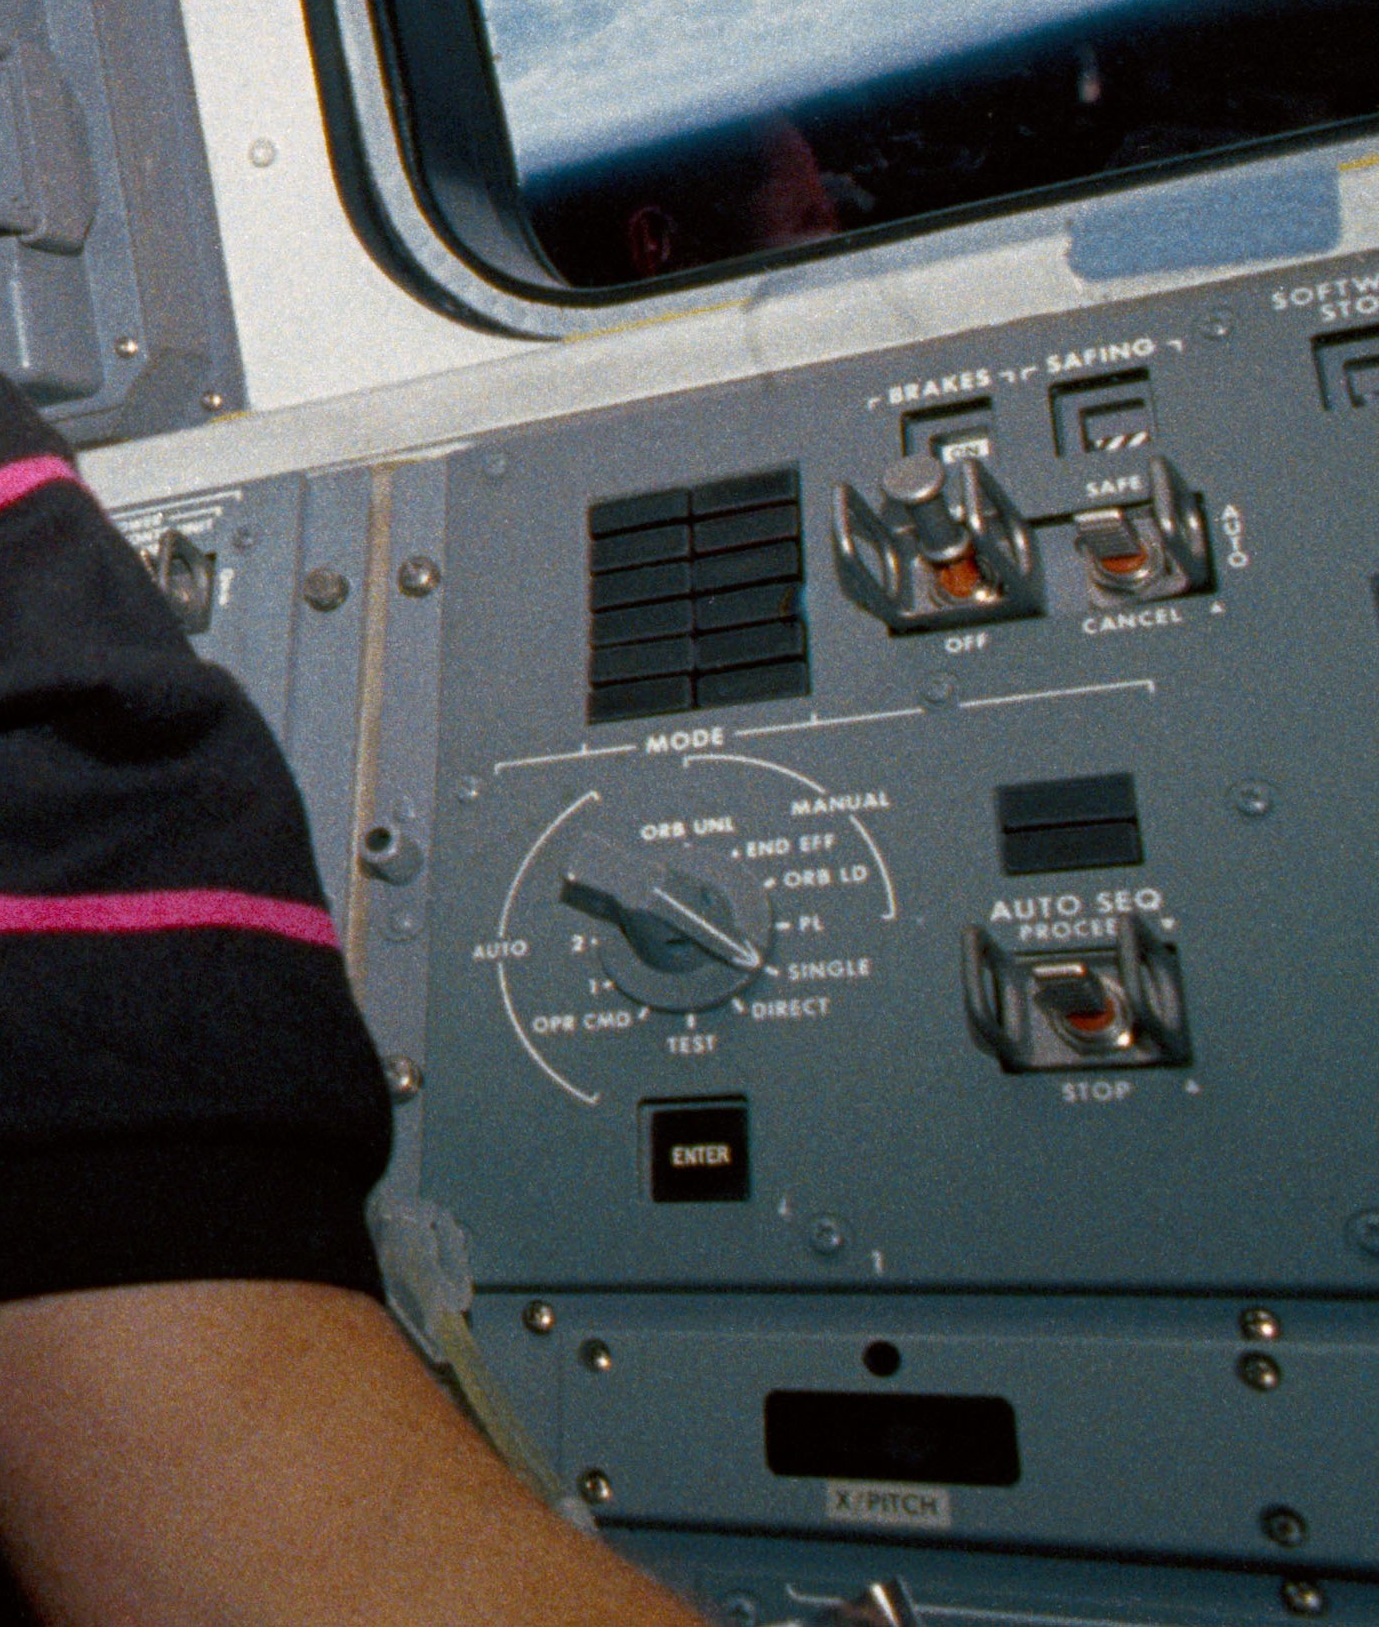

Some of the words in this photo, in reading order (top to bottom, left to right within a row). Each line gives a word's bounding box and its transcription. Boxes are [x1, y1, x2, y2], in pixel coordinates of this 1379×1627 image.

[1271, 275, 1379, 310] SOFTW
[1320, 295, 1379, 322] STO
[889, 369, 992, 404] BRAKES
[1046, 338, 1155, 373] SAFING
[1087, 476, 1144, 498] SAFE
[1222, 504, 1249, 568] AUTO
[1081, 608, 1182, 634] CANCEL
[945, 633, 988, 653] OFF
[646, 727, 725, 754] MODE
[791, 791, 890, 815] MANUAL
[641, 821, 686, 841] ORB
[693, 816, 735, 835] UNL
[746, 838, 790, 857] END
[799, 833, 835, 852] EFF
[783, 867, 831, 888] ORB
[840, 864, 868, 883] LD
[990, 895, 1081, 922] AUTO
[1095, 888, 1162, 914] SEQ
[798, 915, 825, 932] PL
[1019, 918, 1119, 942] PROCEE
[473, 939, 529, 960] AUTO
[571, 934, 585, 953] 2
[788, 958, 871, 981] SINGLE
[751, 997, 830, 1019] DIRECT
[532, 1015, 575, 1034] OPR
[583, 1011, 632, 1030] CMD
[666, 1034, 717, 1055] TEST
[1061, 1080, 1132, 1103] STOP
[671, 1143, 732, 1168] ENTER
